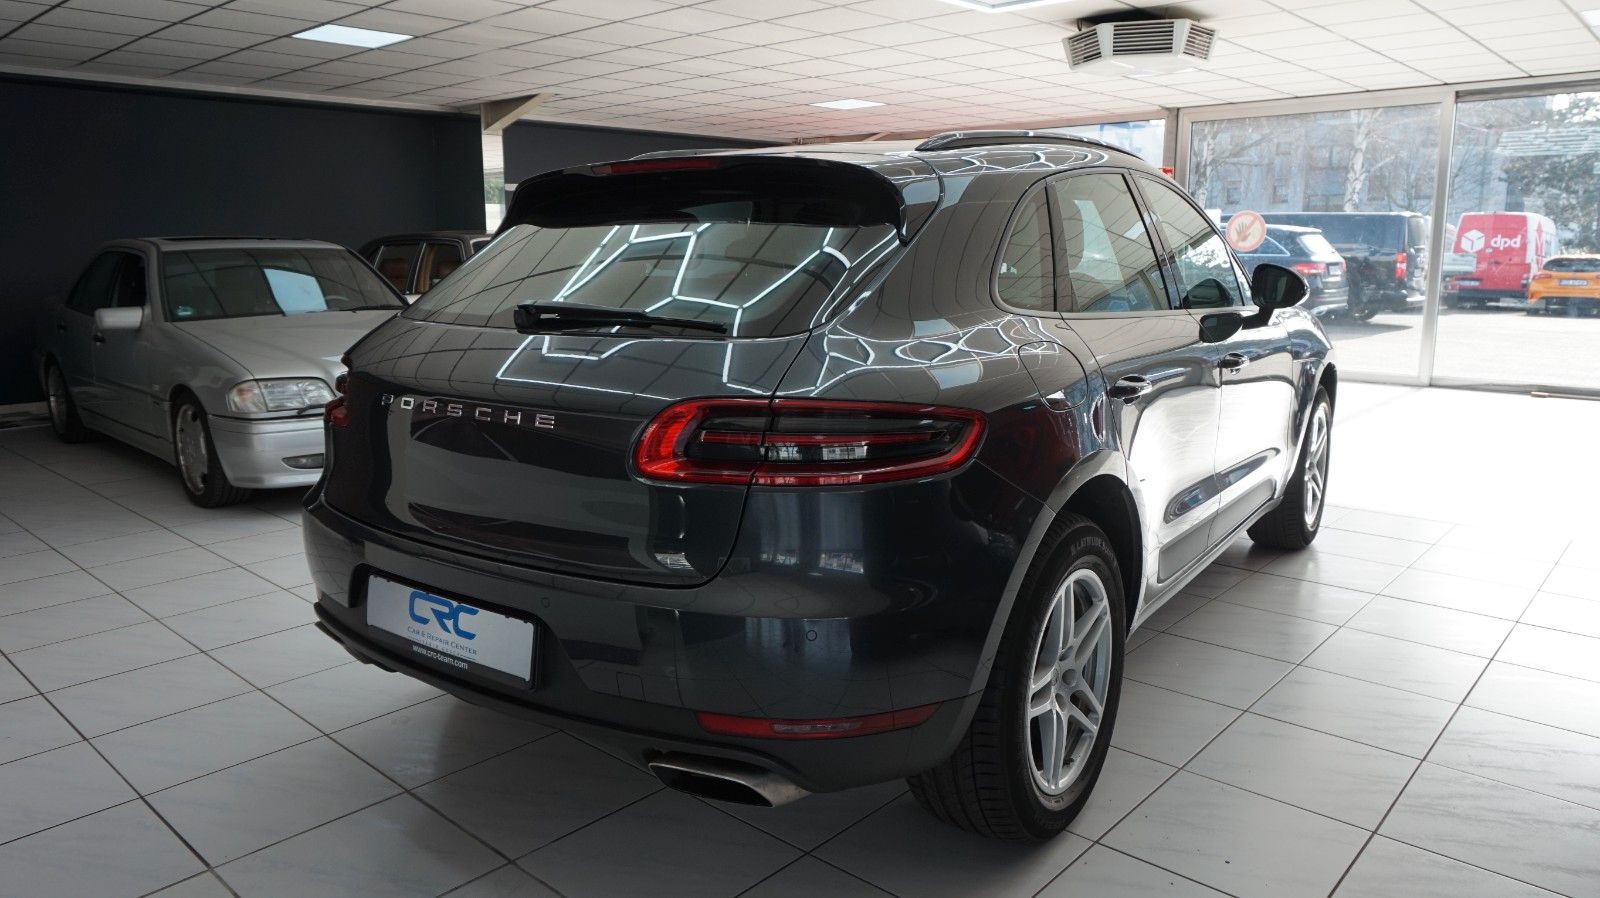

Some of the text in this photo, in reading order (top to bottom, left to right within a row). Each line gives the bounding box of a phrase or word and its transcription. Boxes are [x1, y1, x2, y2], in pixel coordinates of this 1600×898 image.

[1491, 234, 1521, 251] dpd
[381, 394, 555, 429] PORSCHE
[408, 591, 479, 640] CRC
[407, 625, 421, 637] CAR
[426, 631, 449, 646] REPAIR
[450, 640, 477, 655] CENTER
[412, 644, 468, 670] www.crc-team.com
